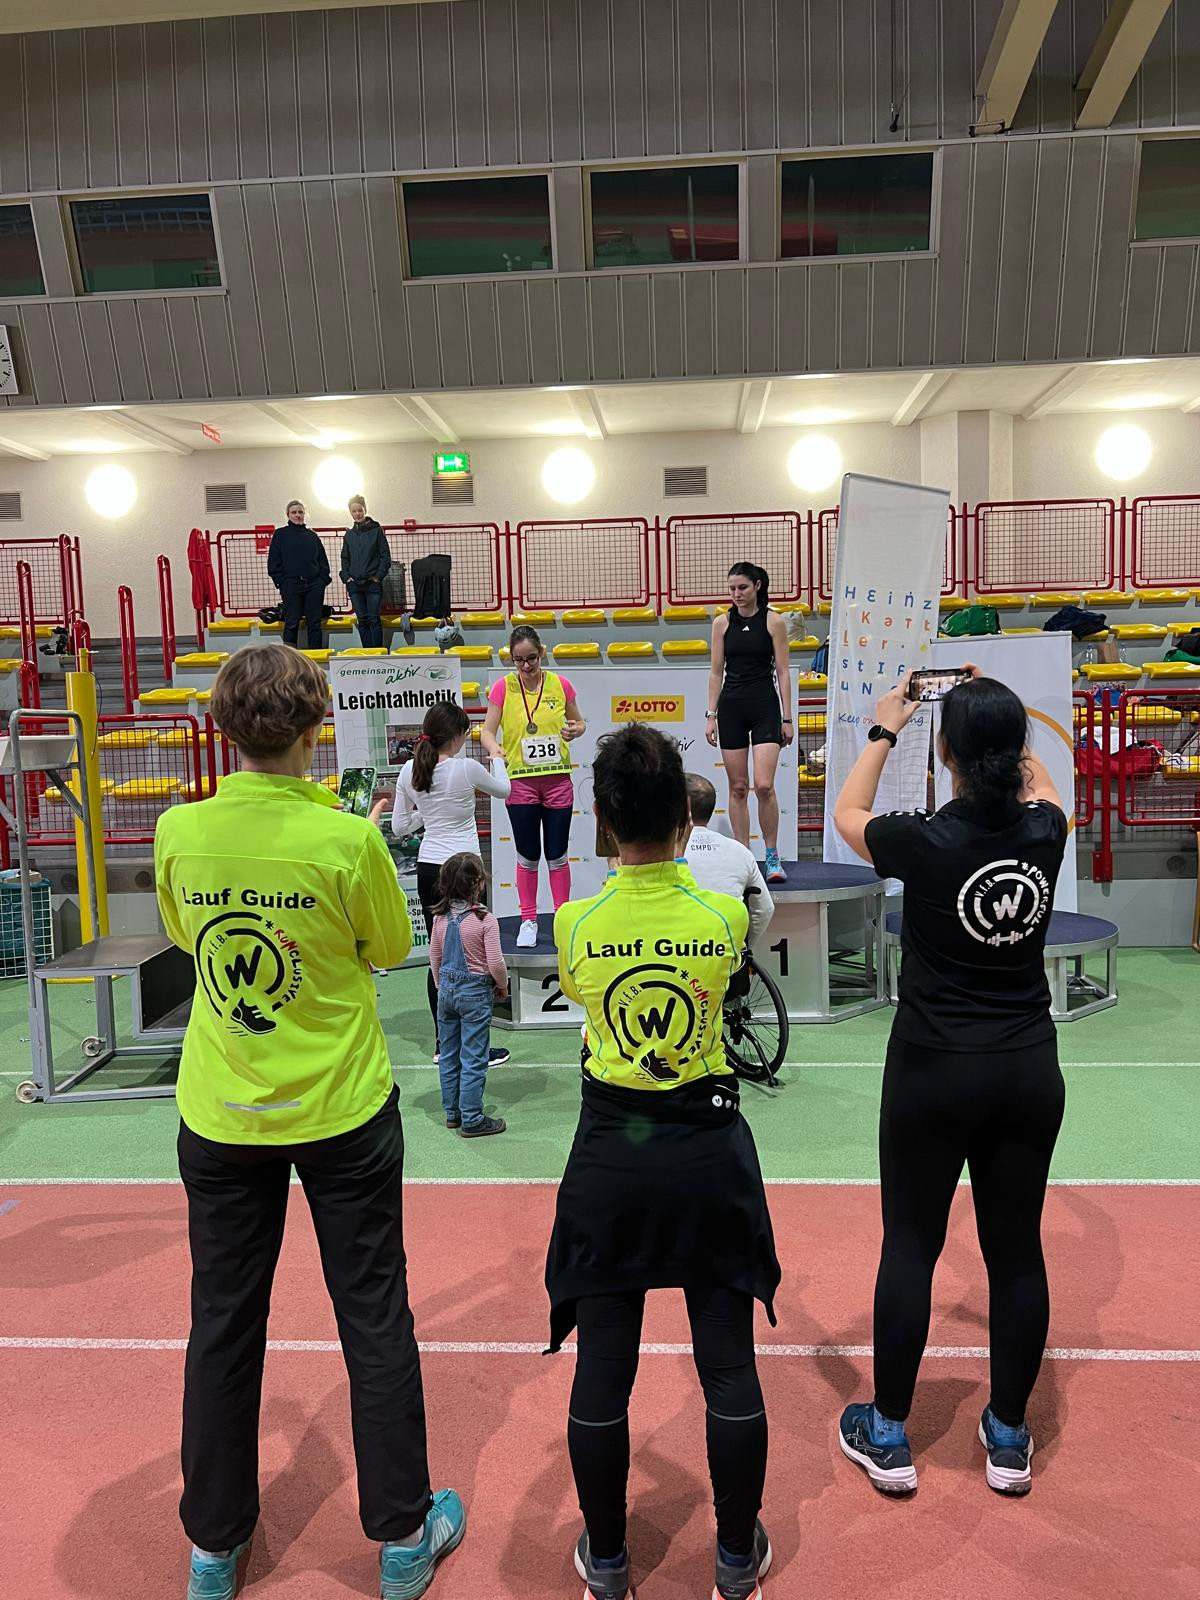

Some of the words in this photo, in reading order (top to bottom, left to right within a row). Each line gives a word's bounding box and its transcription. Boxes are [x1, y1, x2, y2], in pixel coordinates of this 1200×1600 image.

[340, 667, 396, 678] gemeinsam
[385, 664, 421, 685] aktiv
[338, 689, 457, 711] Leichtathletik
[634, 701, 677, 713] LOTTO
[528, 743, 556, 758] 238
[182, 886, 231, 906] Lauf
[241, 888, 316, 909] Guide
[992, 884, 1024, 921] W
[586, 938, 643, 959] Lauf
[654, 938, 726, 958] Guide
[770, 938, 789, 977] 1
[225, 945, 263, 990] W
[541, 974, 569, 1012] 2
[637, 997, 677, 1040] W
